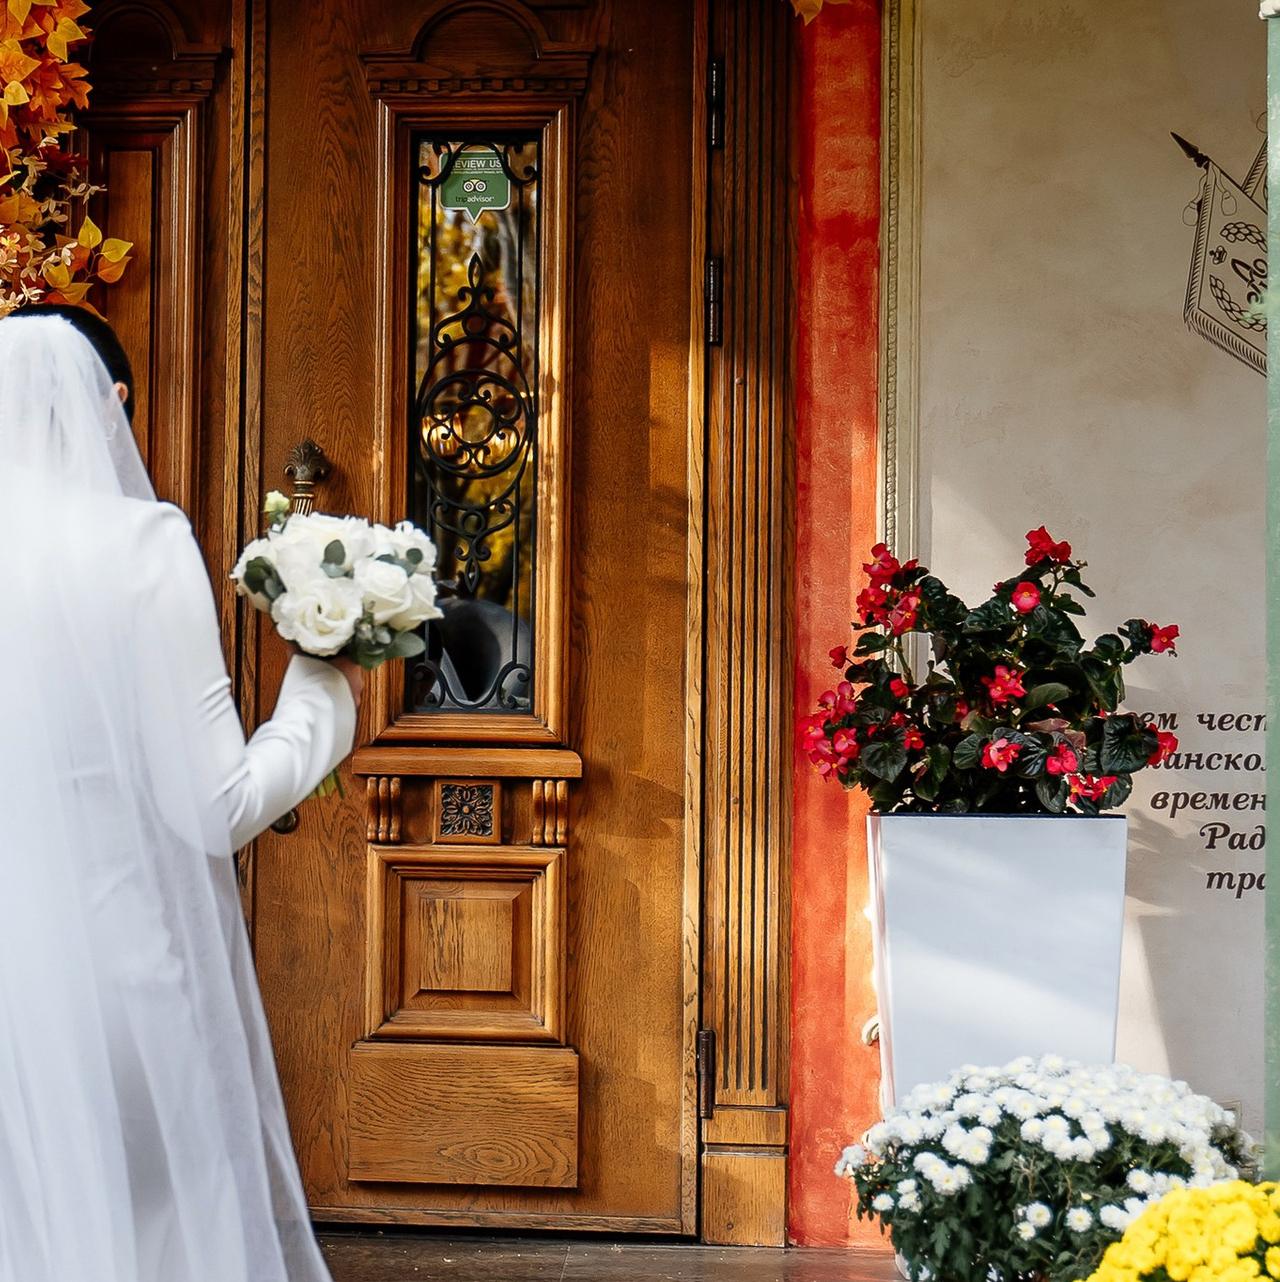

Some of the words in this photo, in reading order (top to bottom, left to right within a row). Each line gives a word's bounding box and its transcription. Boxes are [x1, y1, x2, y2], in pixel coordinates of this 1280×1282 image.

[453, 159, 486, 168] EVIEW
[489, 159, 502, 168] US
[1199, 822, 1266, 850] Рад
